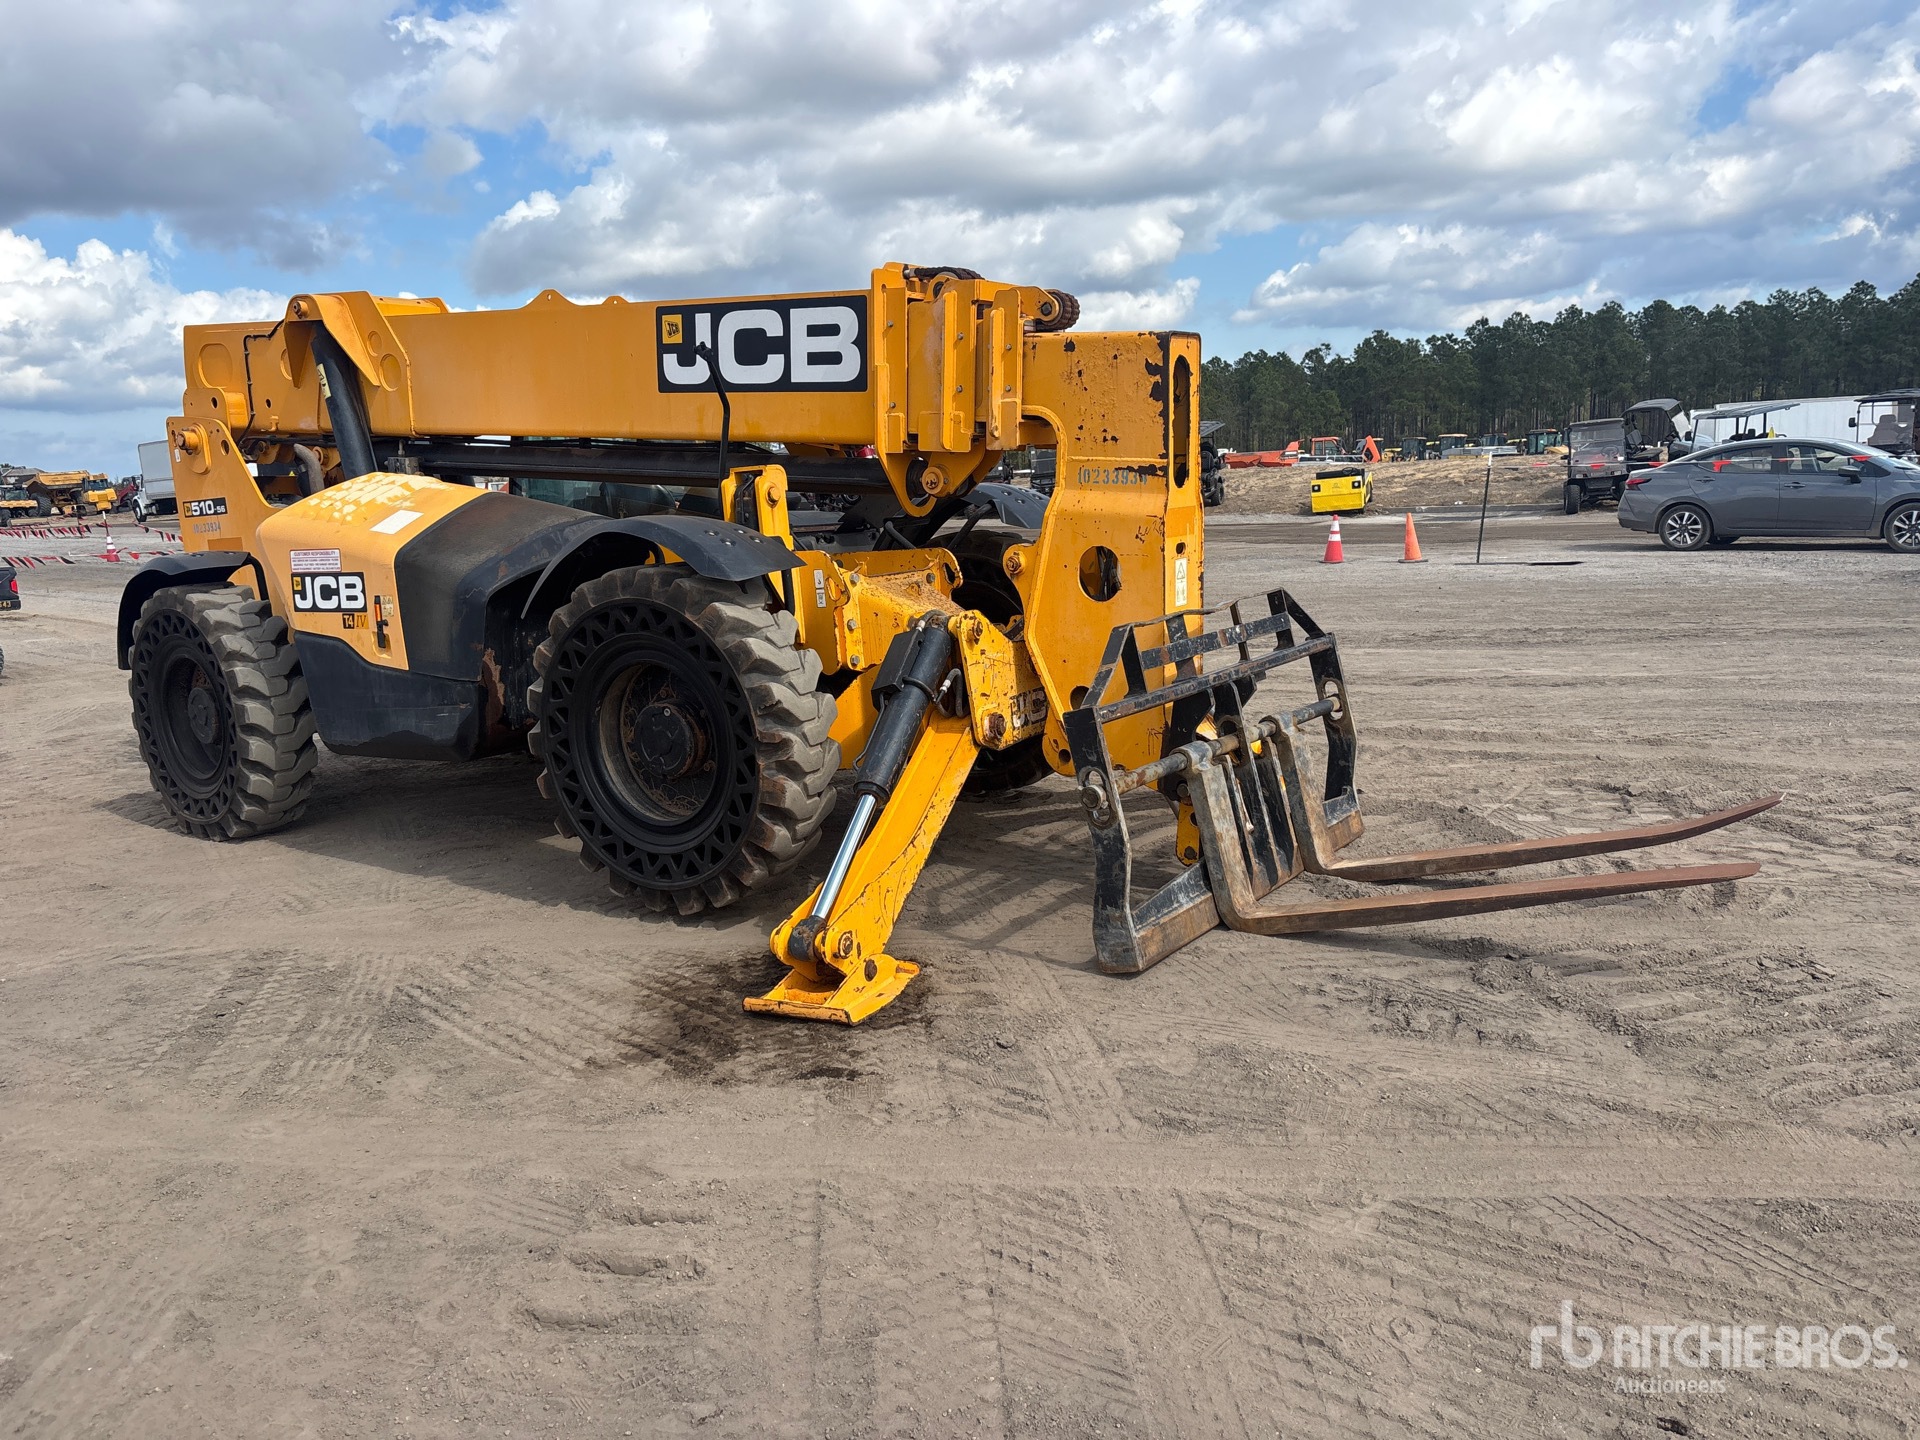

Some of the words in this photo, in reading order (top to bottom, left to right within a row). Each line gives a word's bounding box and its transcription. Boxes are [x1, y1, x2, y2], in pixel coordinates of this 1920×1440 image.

[663, 306, 861, 385] JCB
[294, 575, 366, 609] JCB
[343, 615, 354, 628] T4
